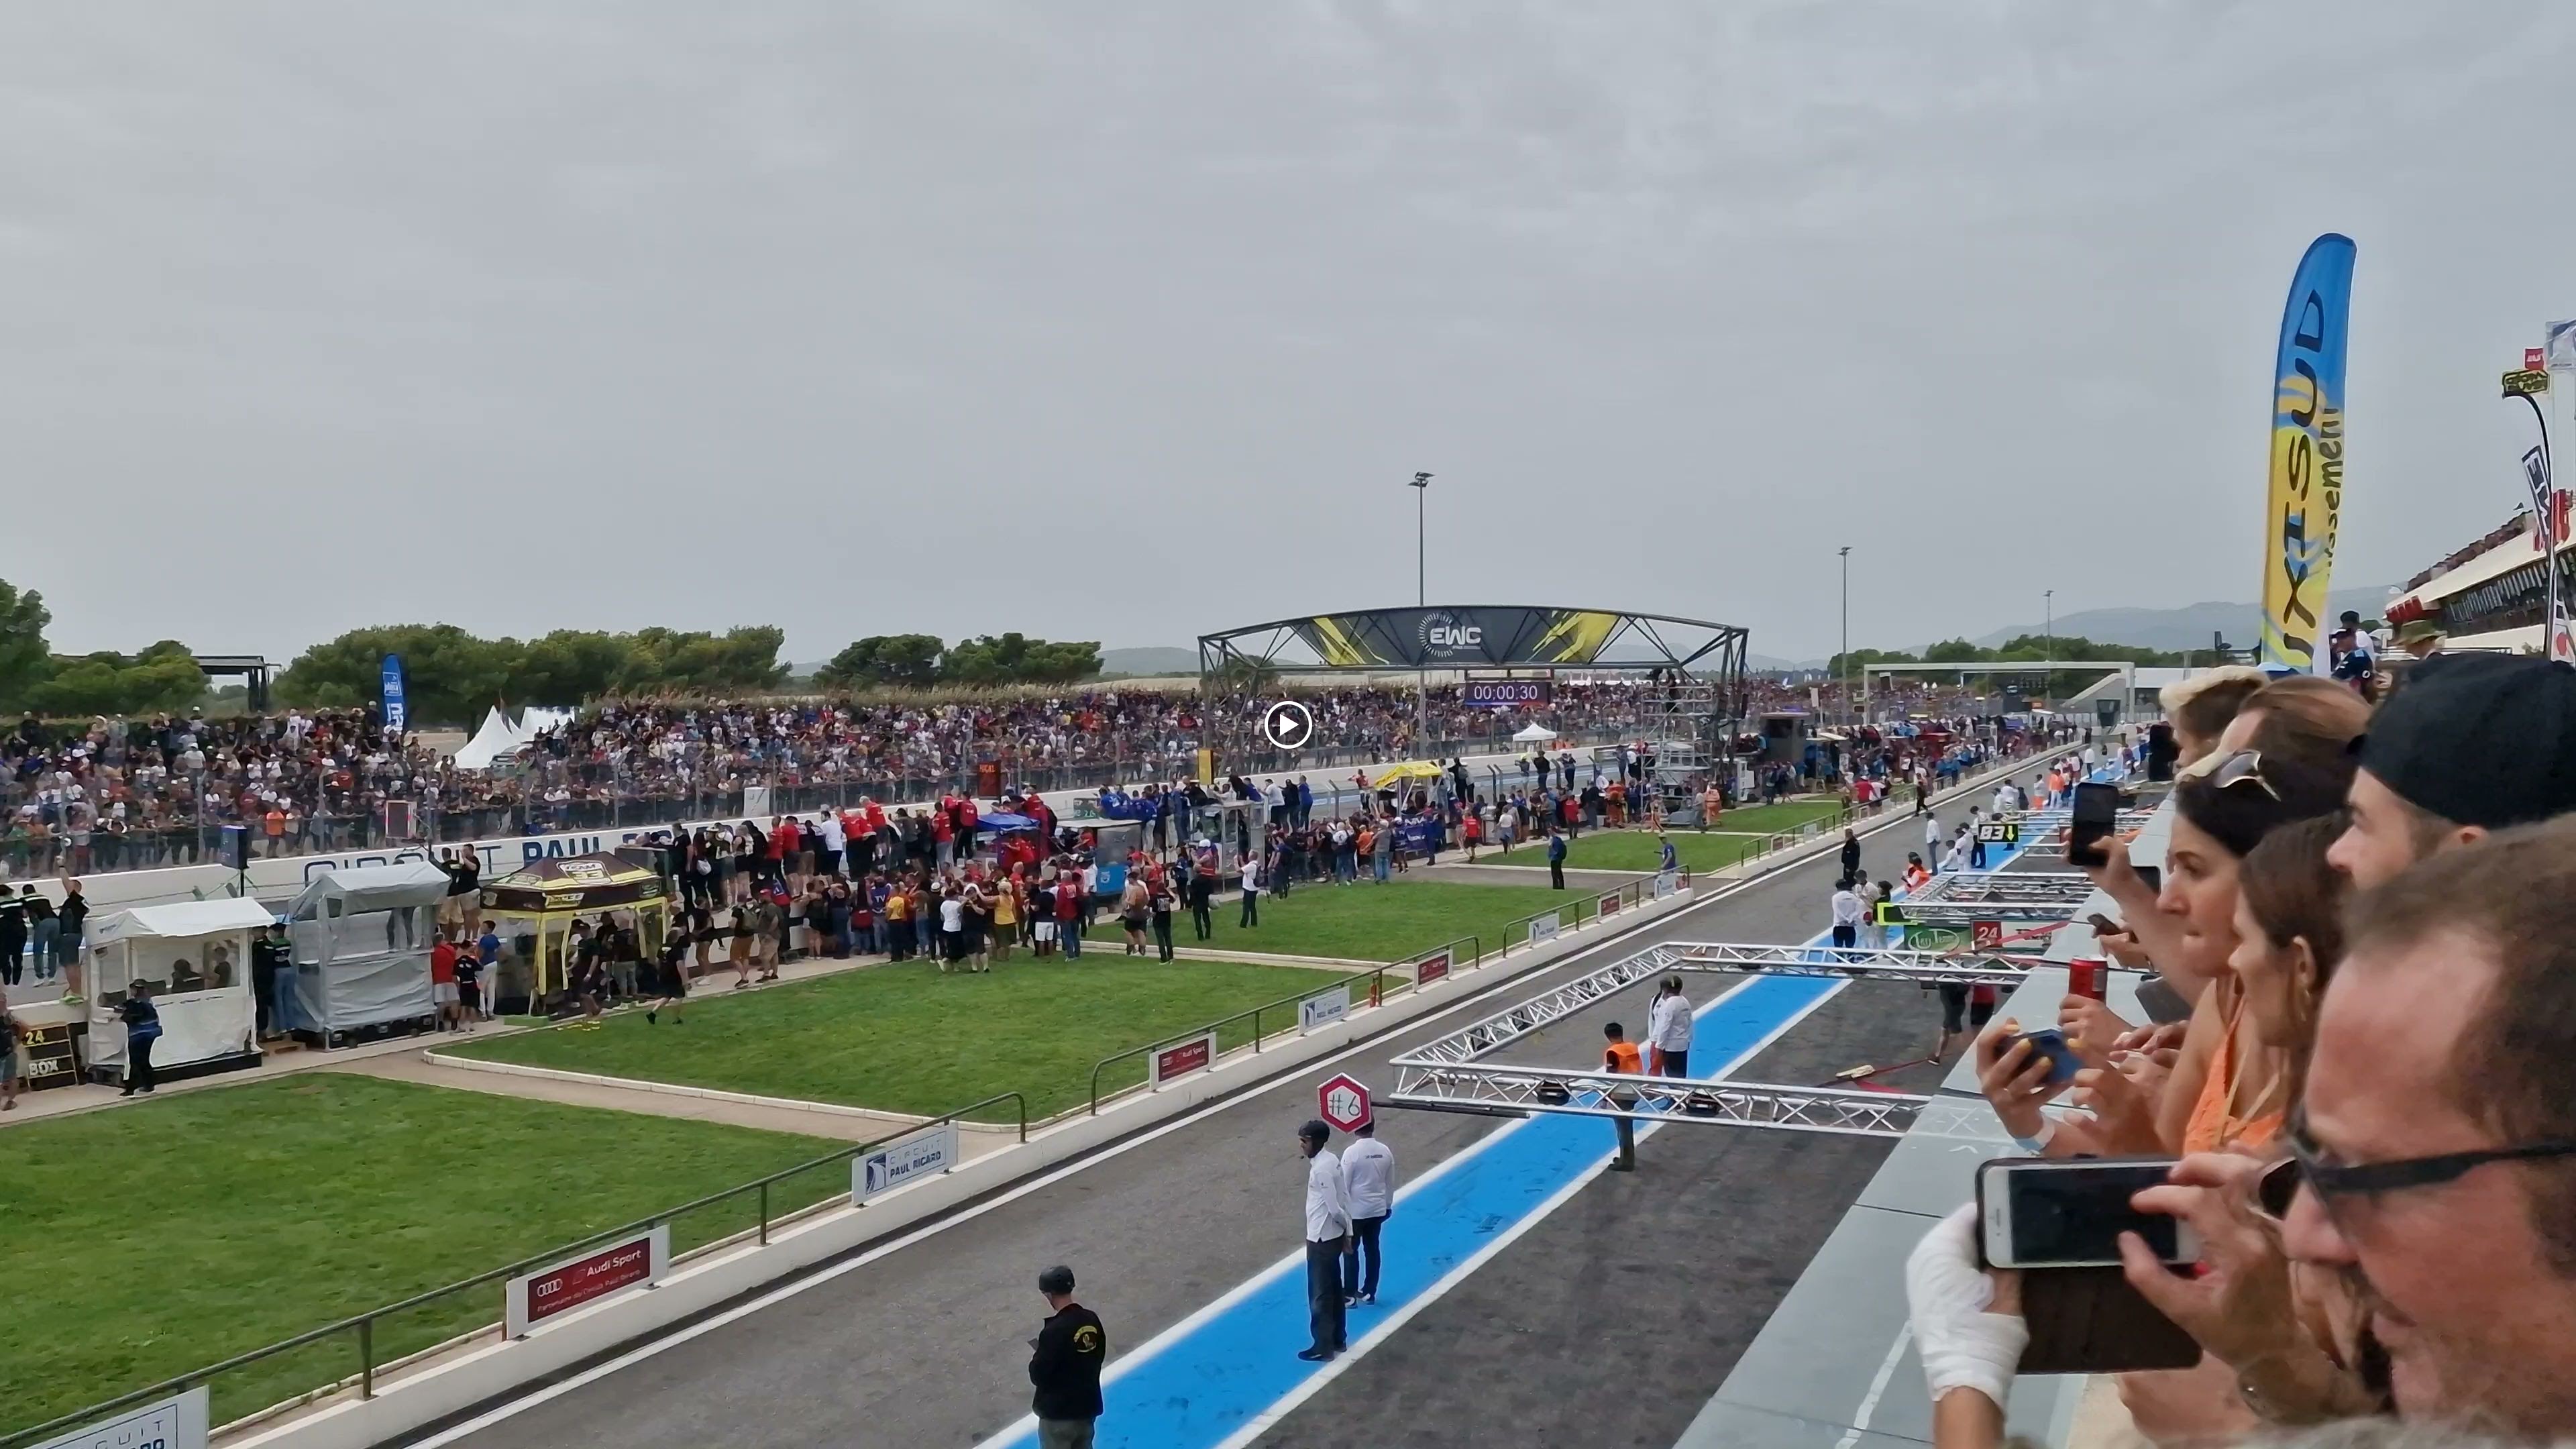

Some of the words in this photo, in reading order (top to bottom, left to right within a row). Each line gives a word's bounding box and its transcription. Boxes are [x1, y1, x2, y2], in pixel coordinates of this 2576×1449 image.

[1430, 625, 1481, 645] EWC
[1473, 685, 1538, 700] 00:00:30
[1980, 825, 2005, 841] 83
[1978, 926, 1998, 940] 24
[29, 1060, 59, 1075] BOX
[890, 1163, 910, 1179] PAUL
[913, 1150, 941, 1169] RICARD
[586, 1258, 610, 1277] Audi
[612, 1249, 642, 1268] Sport
